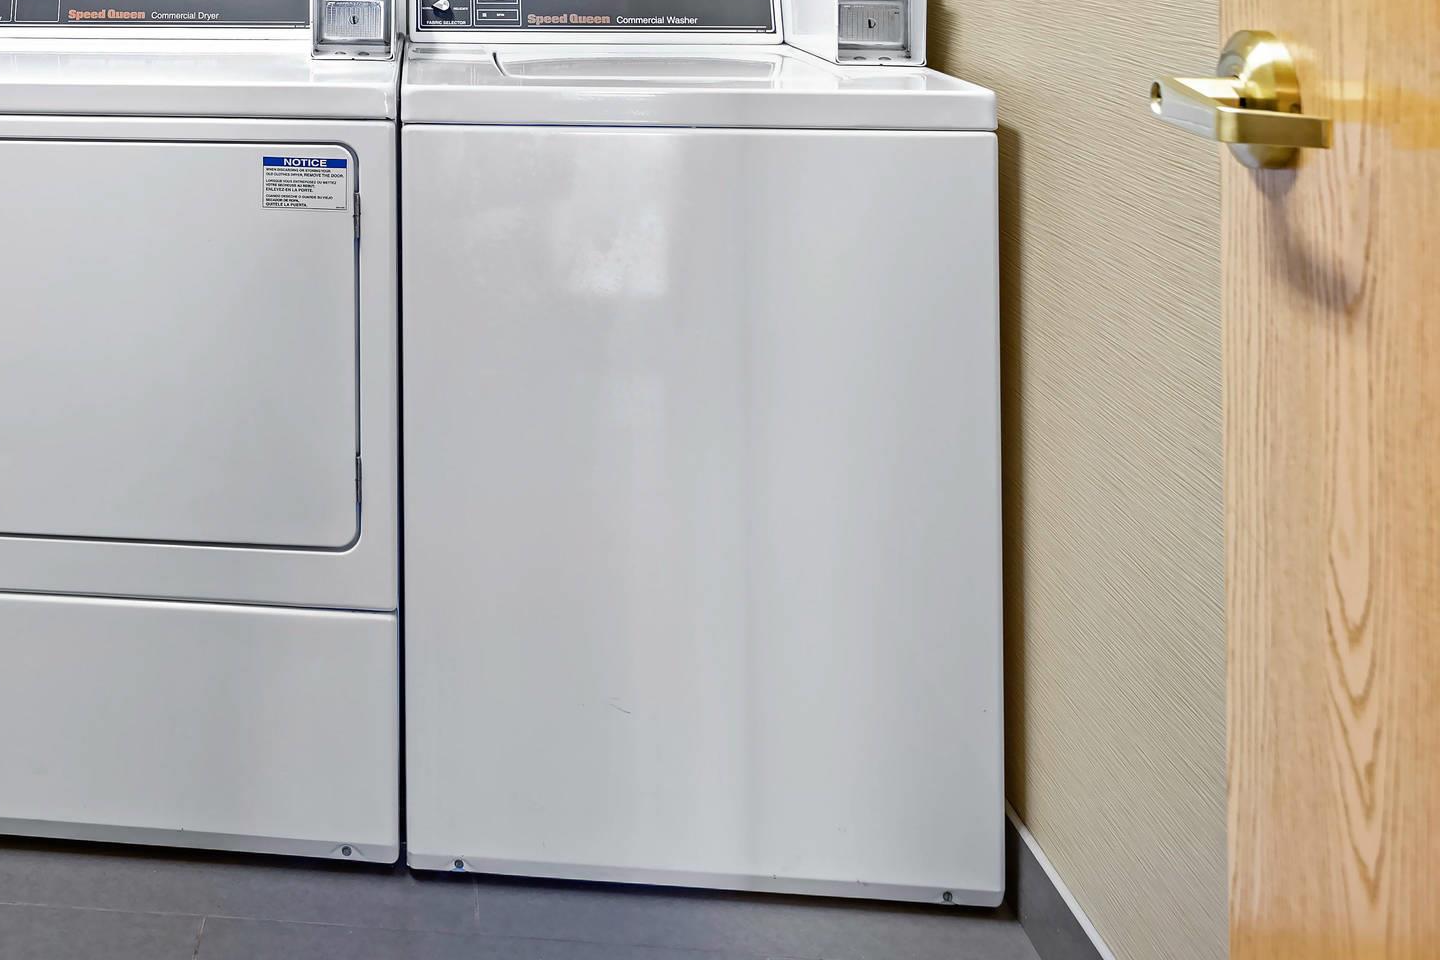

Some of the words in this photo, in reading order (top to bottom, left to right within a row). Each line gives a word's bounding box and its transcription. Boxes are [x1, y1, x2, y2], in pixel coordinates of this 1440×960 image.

[68, 9, 106, 21] Speed
[107, 9, 146, 20] Queen
[151, 11, 197, 20] Commercial
[198, 12, 220, 21] Dryer
[527, 13, 568, 26] Speed
[569, 13, 611, 24] Queen
[616, 16, 664, 24] Commercial
[666, 16, 699, 24] Washer
[284, 158, 327, 167] NOTICE
